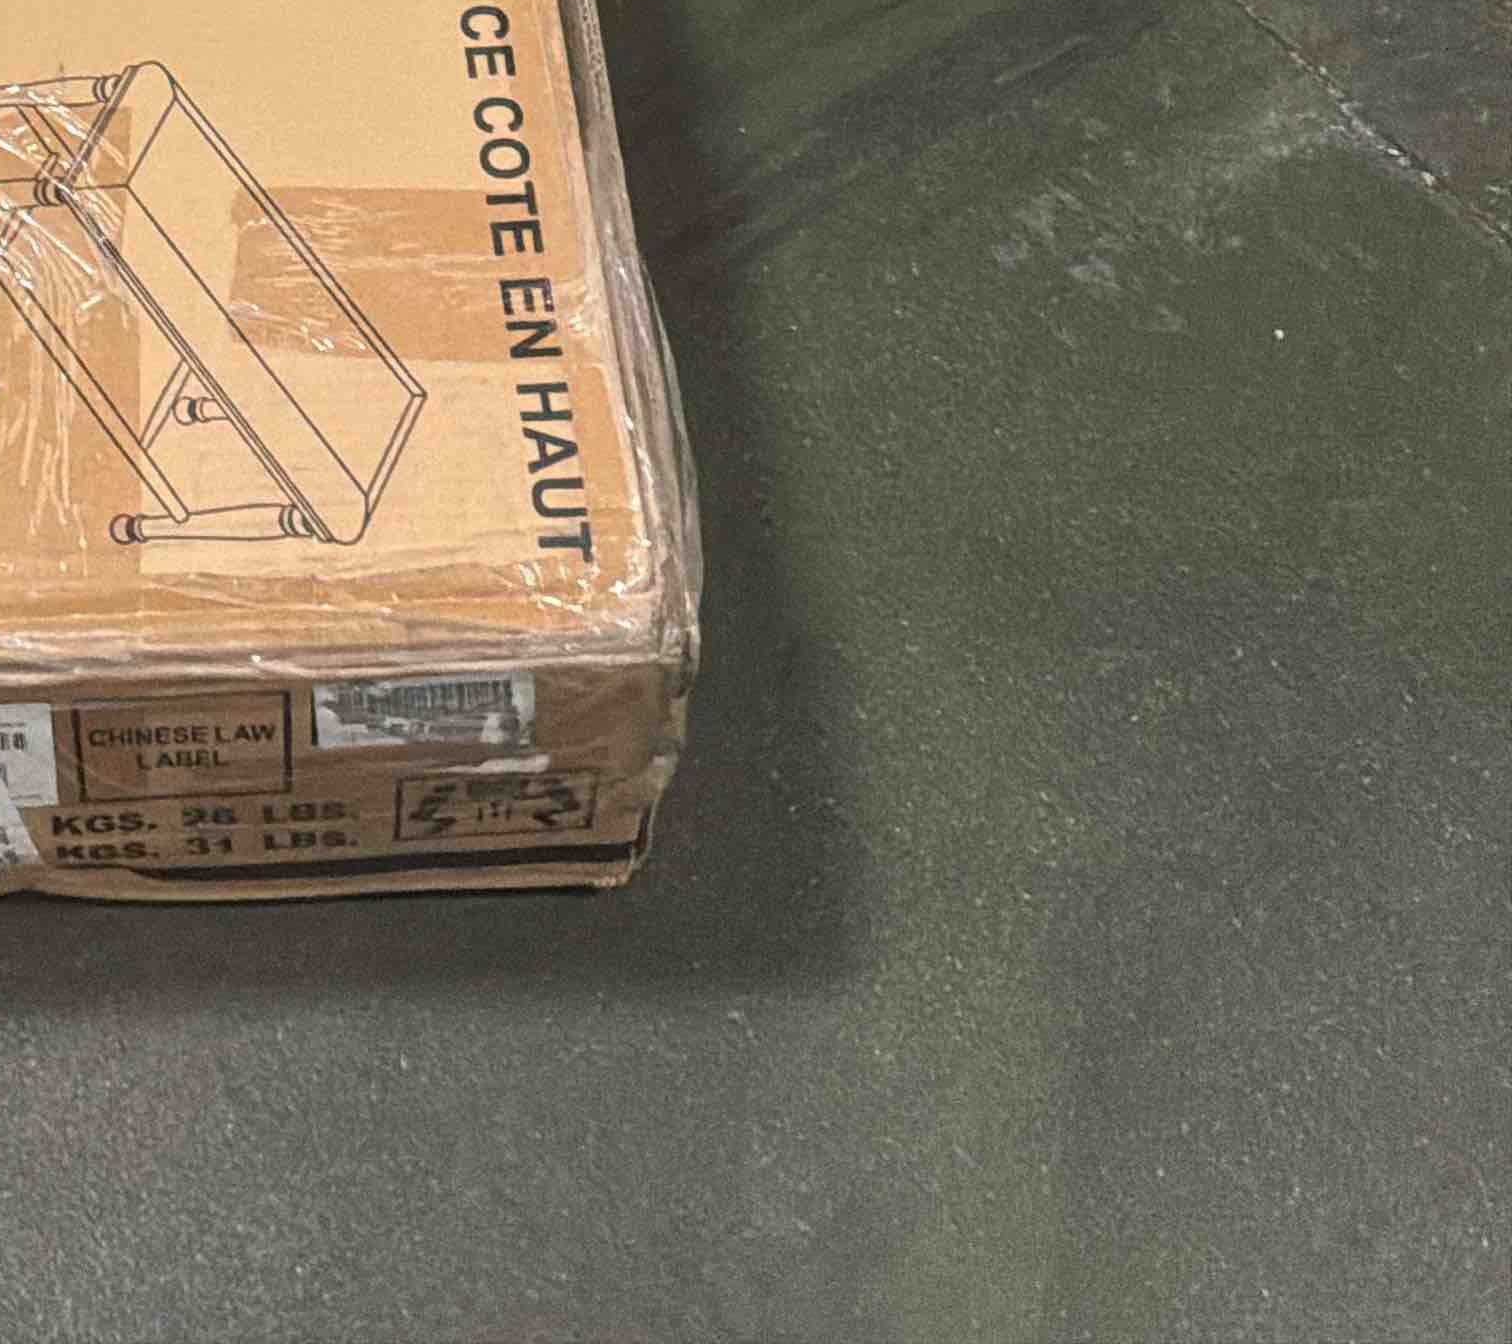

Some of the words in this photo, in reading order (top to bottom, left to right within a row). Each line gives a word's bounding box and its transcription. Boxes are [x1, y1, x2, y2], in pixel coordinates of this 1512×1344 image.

[460, 4, 517, 80] CE
[472, 95, 546, 257] COTE
[498, 277, 564, 361] EN
[515, 381, 594, 563] HAUT
[88, 726, 208, 748] CHINESE
[215, 723, 276, 744] LAW
[136, 749, 229, 770] LABEL
